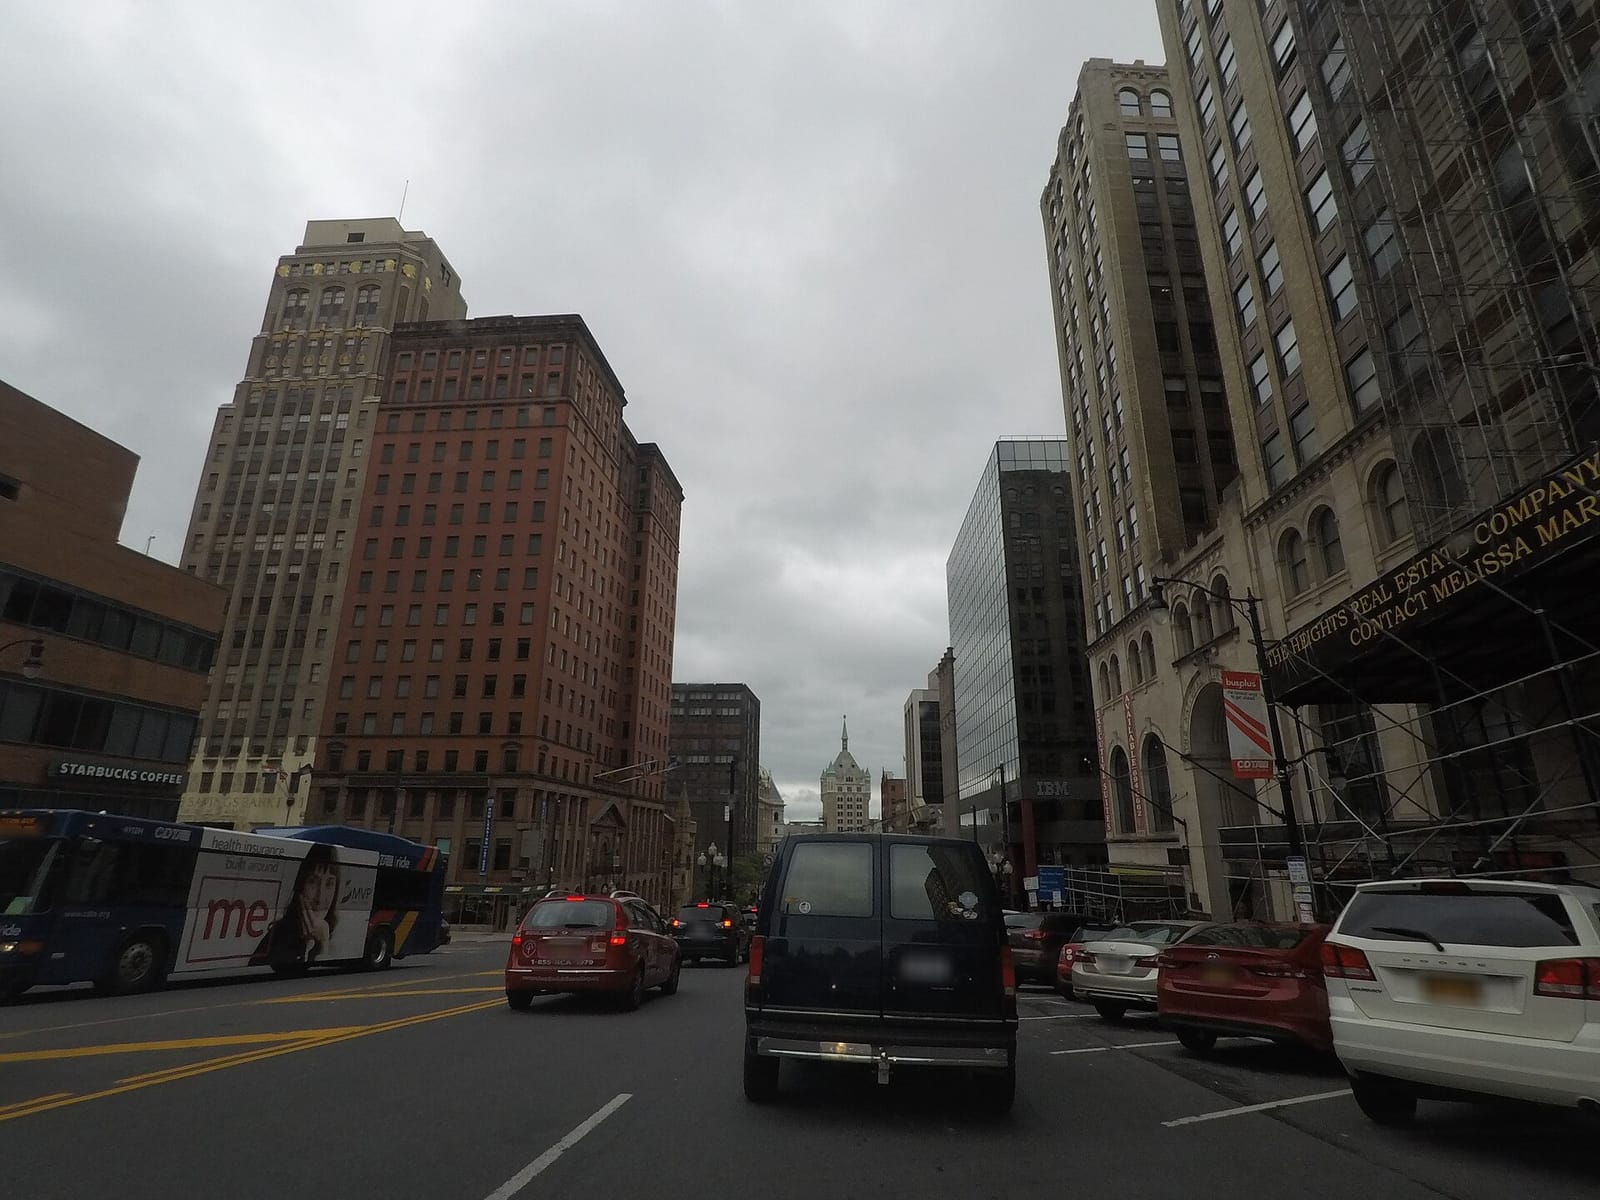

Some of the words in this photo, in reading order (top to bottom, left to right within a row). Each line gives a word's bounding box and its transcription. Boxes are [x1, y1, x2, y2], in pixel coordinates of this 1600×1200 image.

[1265, 645, 1289, 667] THE
[1290, 609, 1348, 654] HEIGHTS
[1351, 583, 1392, 619] REAL
[1393, 543, 1469, 594] ESTAT
[1474, 452, 1600, 545] COMPANY
[1350, 590, 1428, 646] CONTACT
[1431, 536, 1533, 603] MELISSA
[1226, 678, 1257, 689] busplus
[1124, 694, 1137, 766] AVAILABLE
[59, 762, 137, 781] STARBUCKS
[139, 771, 183, 785] COFFEE
[1037, 781, 1073, 796] IBM
[211, 835, 242, 851] health
[243, 841, 285, 855] insurance
[352, 887, 372, 900] MVP
